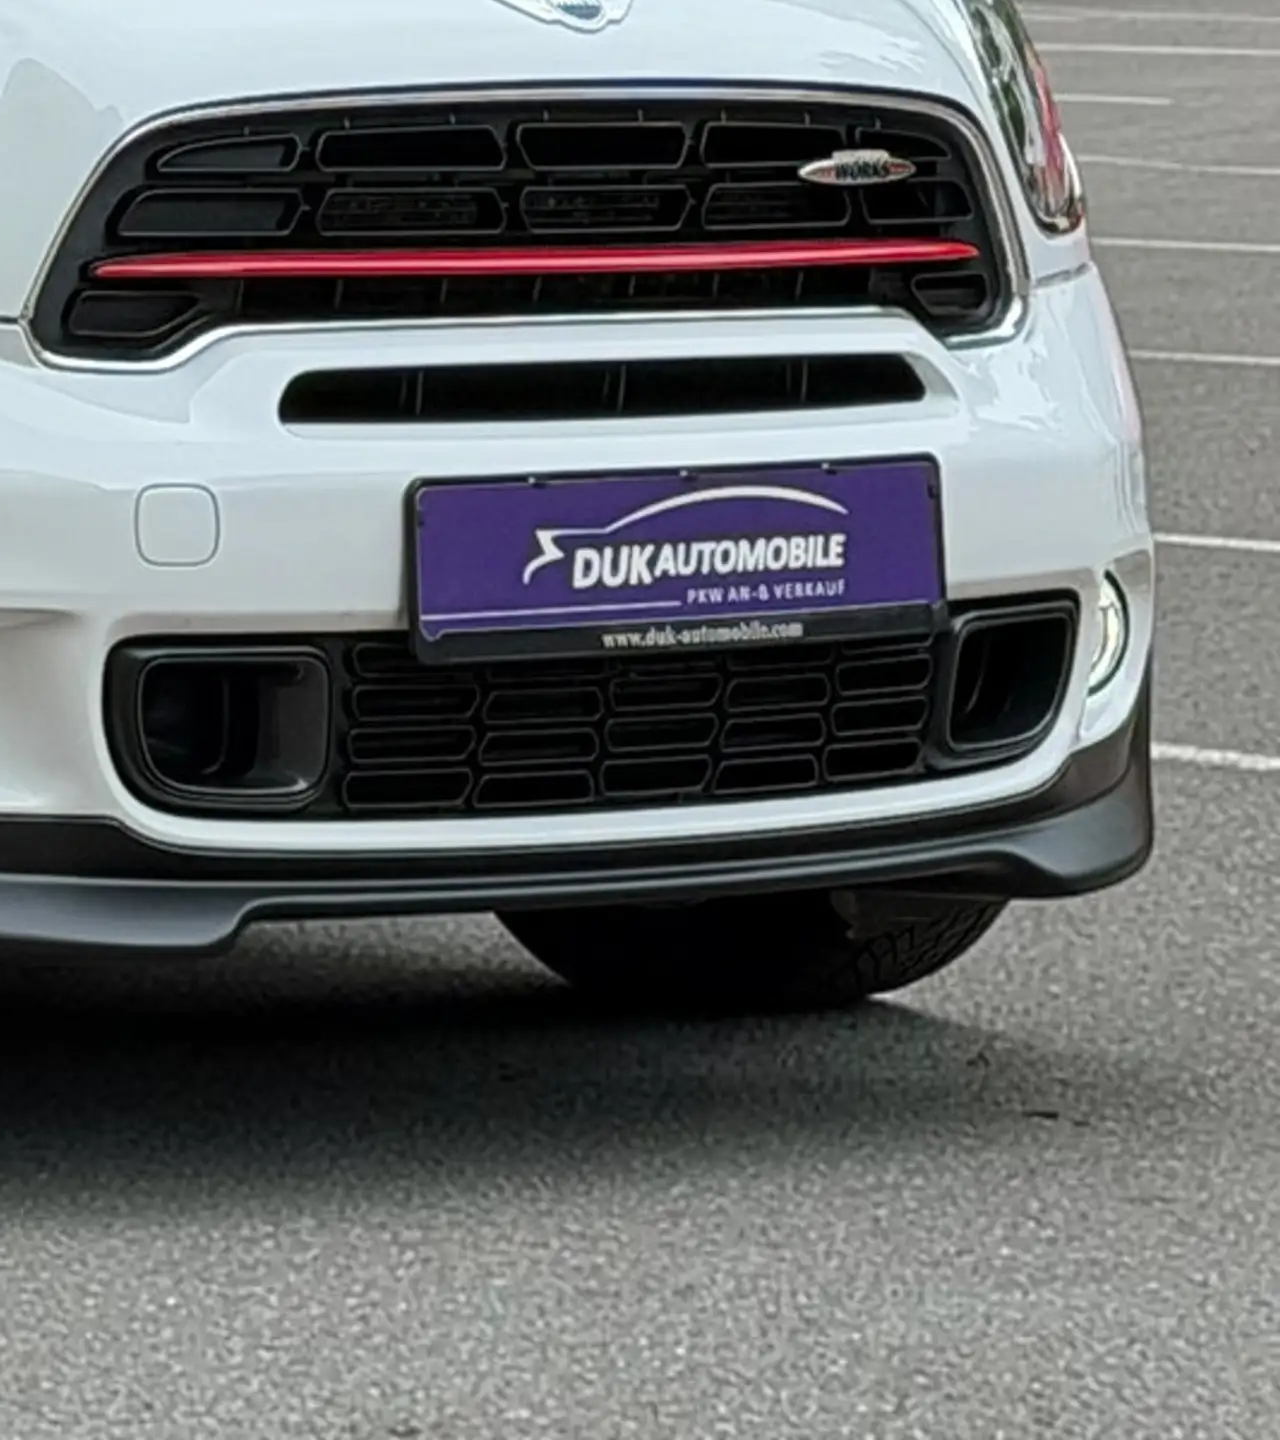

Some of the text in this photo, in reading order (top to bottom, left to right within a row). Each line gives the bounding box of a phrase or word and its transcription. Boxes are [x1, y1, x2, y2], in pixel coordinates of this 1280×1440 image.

[686, 586, 724, 604] PKW
[773, 578, 846, 600] VERKAUF
[600, 621, 804, 649] www.duk-automobile.com
